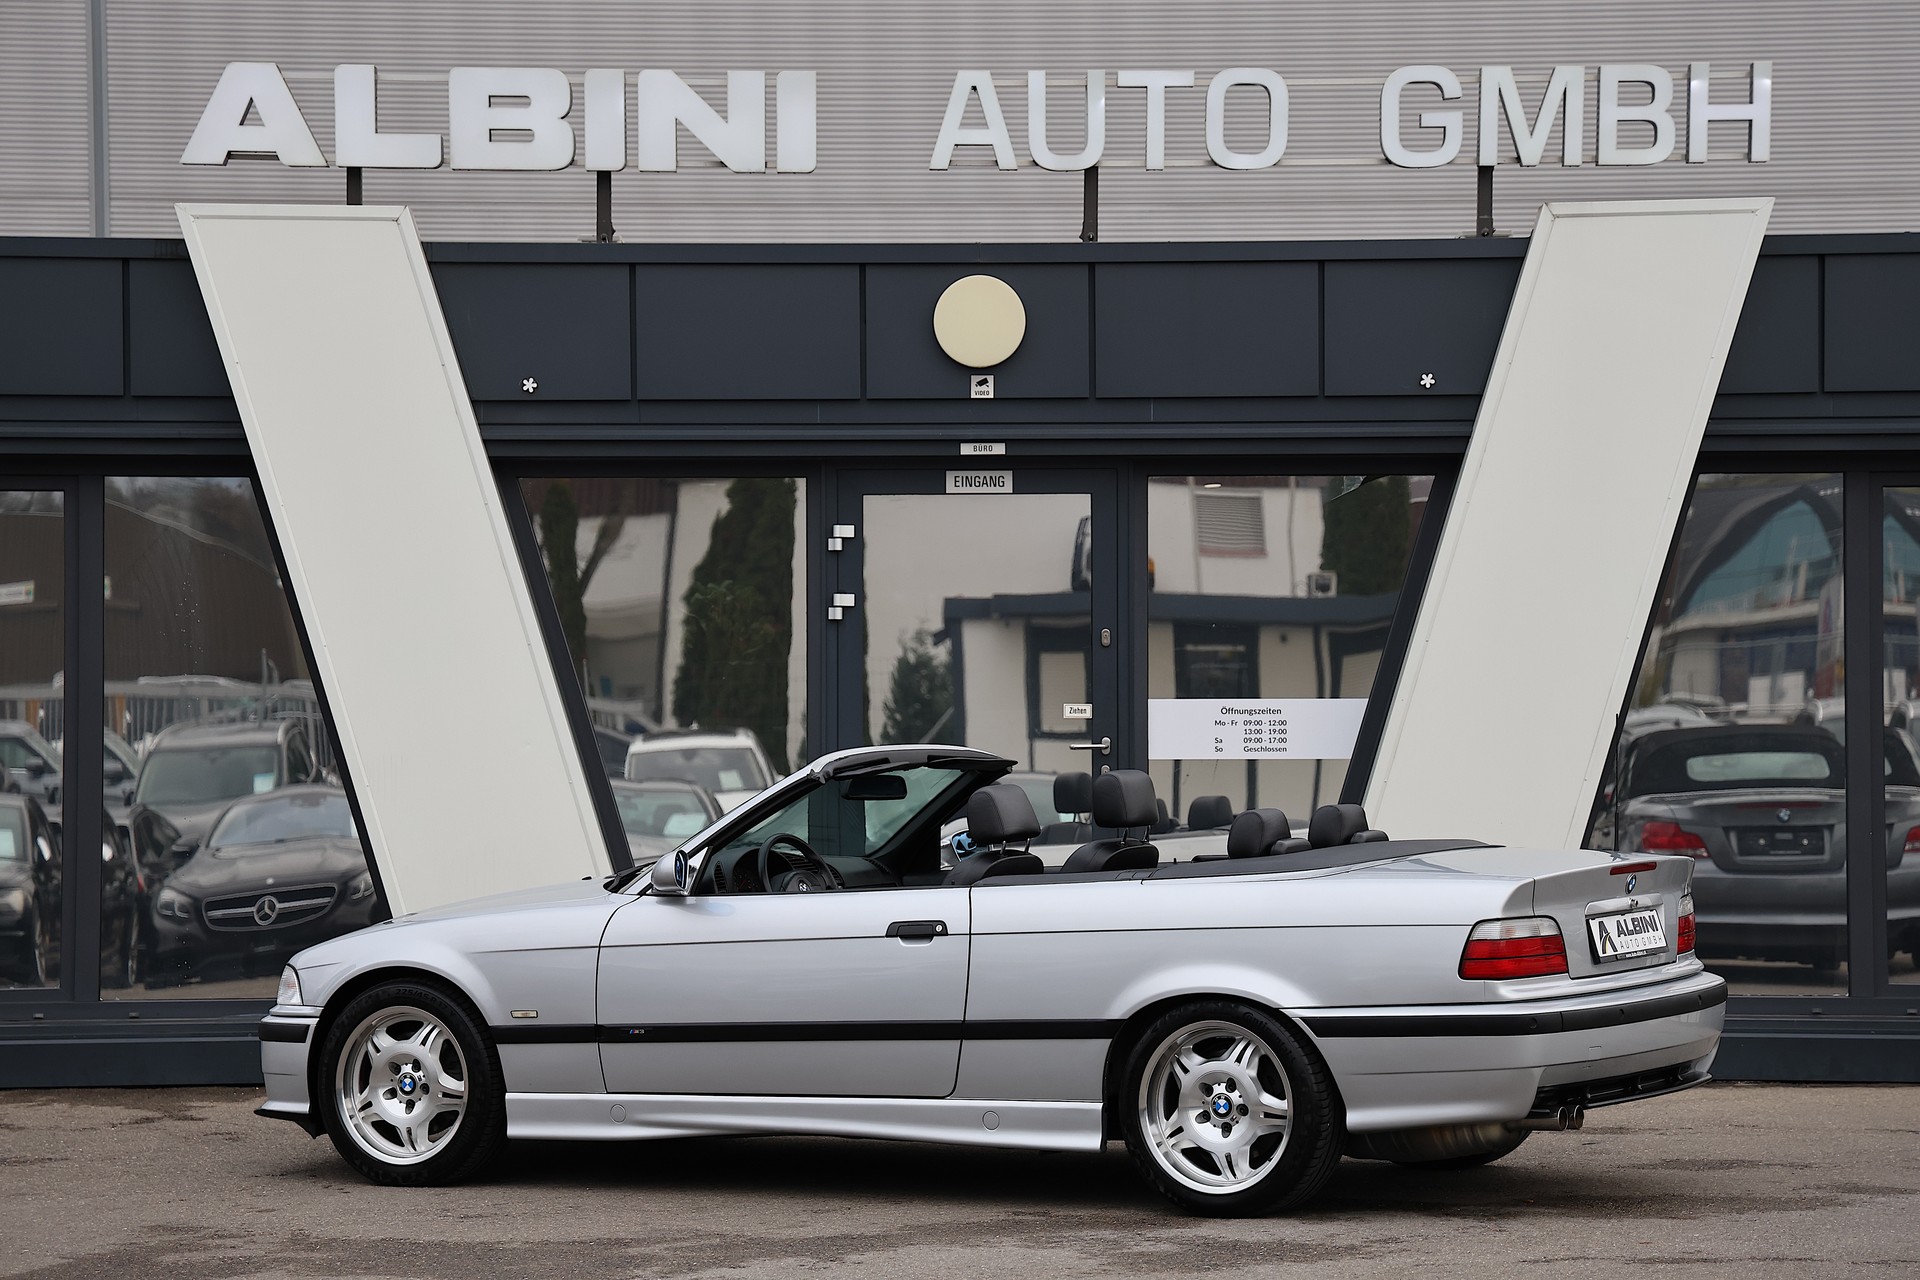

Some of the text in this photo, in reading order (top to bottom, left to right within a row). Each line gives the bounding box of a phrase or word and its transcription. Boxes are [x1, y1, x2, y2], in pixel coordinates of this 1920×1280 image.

[179, 60, 1773, 174] ALBINI AUTO GMBH
[973, 443, 993, 452] BÜRO
[954, 475, 1005, 488] EINGANG
[1220, 706, 1282, 716] Öffnungszeiten
[1214, 719, 1226, 727] Mo
[1231, 719, 1238, 727] Fr
[1243, 719, 1263, 727] 09:00
[1268, 719, 1287, 727] 12:00
[1214, 745, 1287, 753] So Geschlossen
[1616, 914, 1659, 938] ALBINI
[1619, 938, 1640, 950] AUTO
